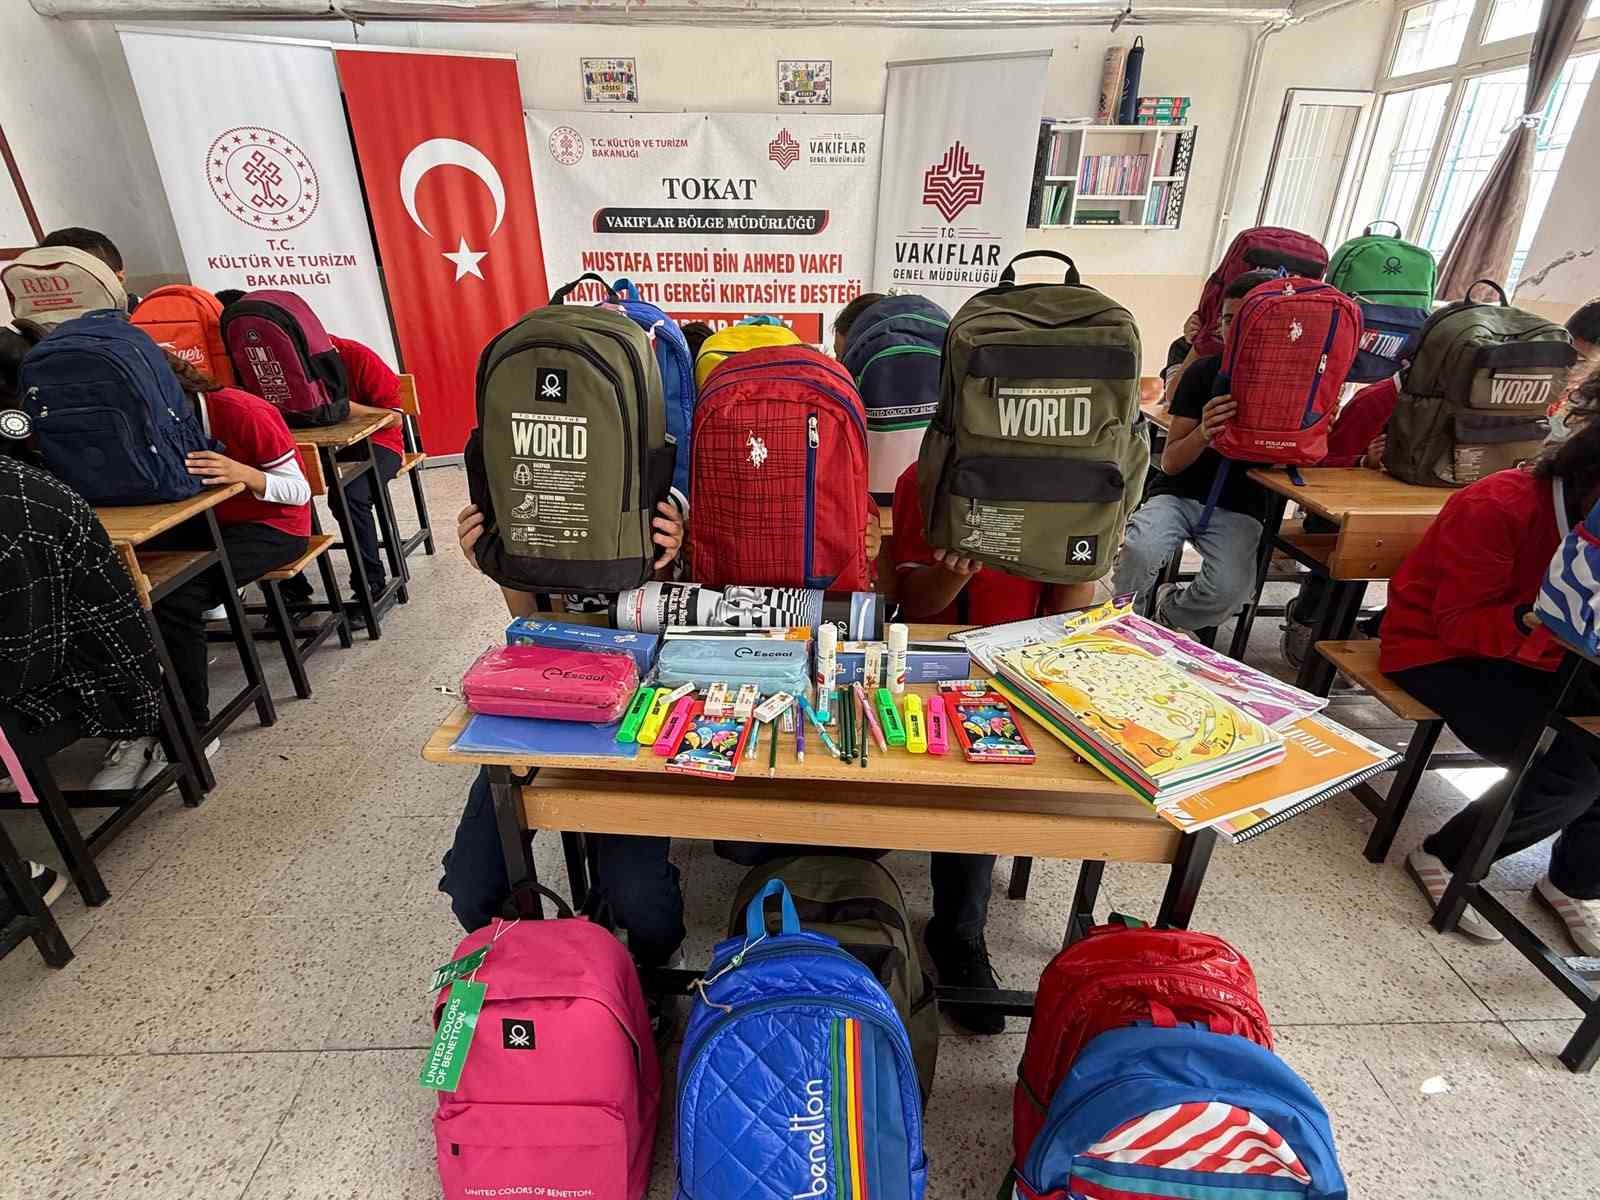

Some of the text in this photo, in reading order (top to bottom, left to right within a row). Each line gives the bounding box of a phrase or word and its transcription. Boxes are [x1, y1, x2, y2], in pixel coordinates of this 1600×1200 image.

[591, 138, 606, 147] T.C.
[608, 138, 641, 148] KÜLTÜR
[655, 138, 688, 147] TURİZM
[809, 142, 866, 154] VAKIFLAR
[592, 149, 639, 158] BAKANLIĞI
[662, 178, 757, 200] TOKAT
[606, 215, 816, 230] VAKIFLAR BÖLGE MÜDÜRLÜĞÜ
[266, 239, 295, 251] T.C.
[895, 242, 1001, 266] VAKIFLAR
[208, 253, 357, 269] KÜLTÜR VE TURİZM
[582, 247, 843, 273] MUSTAFA EFENDİ BİN AHMED VAKFI
[21, 275, 70, 293] RED
[246, 271, 331, 287] BAKANLIĞI
[893, 267, 998, 283] GENEL MÜDÜRLÜĞÜ
[663, 278, 716, 303] GEREĞİ
[720, 279, 796, 303] KIRTASİYE
[800, 279, 861, 304] DESTEĞİ
[1490, 379, 1552, 404] WORLD
[998, 397, 1091, 437] WORLD
[511, 421, 588, 460] WORLD
[562, 671, 606, 682] Escool
[427, 1042, 446, 1084] UNITED
[440, 998, 461, 1041] COLORS
[435, 1067, 447, 1086] OF
[788, 1078, 828, 1200] benetton
[464, 1186, 497, 1197] UNITED
[498, 1186, 533, 1196] COLORS
[534, 1186, 546, 1195] OF
